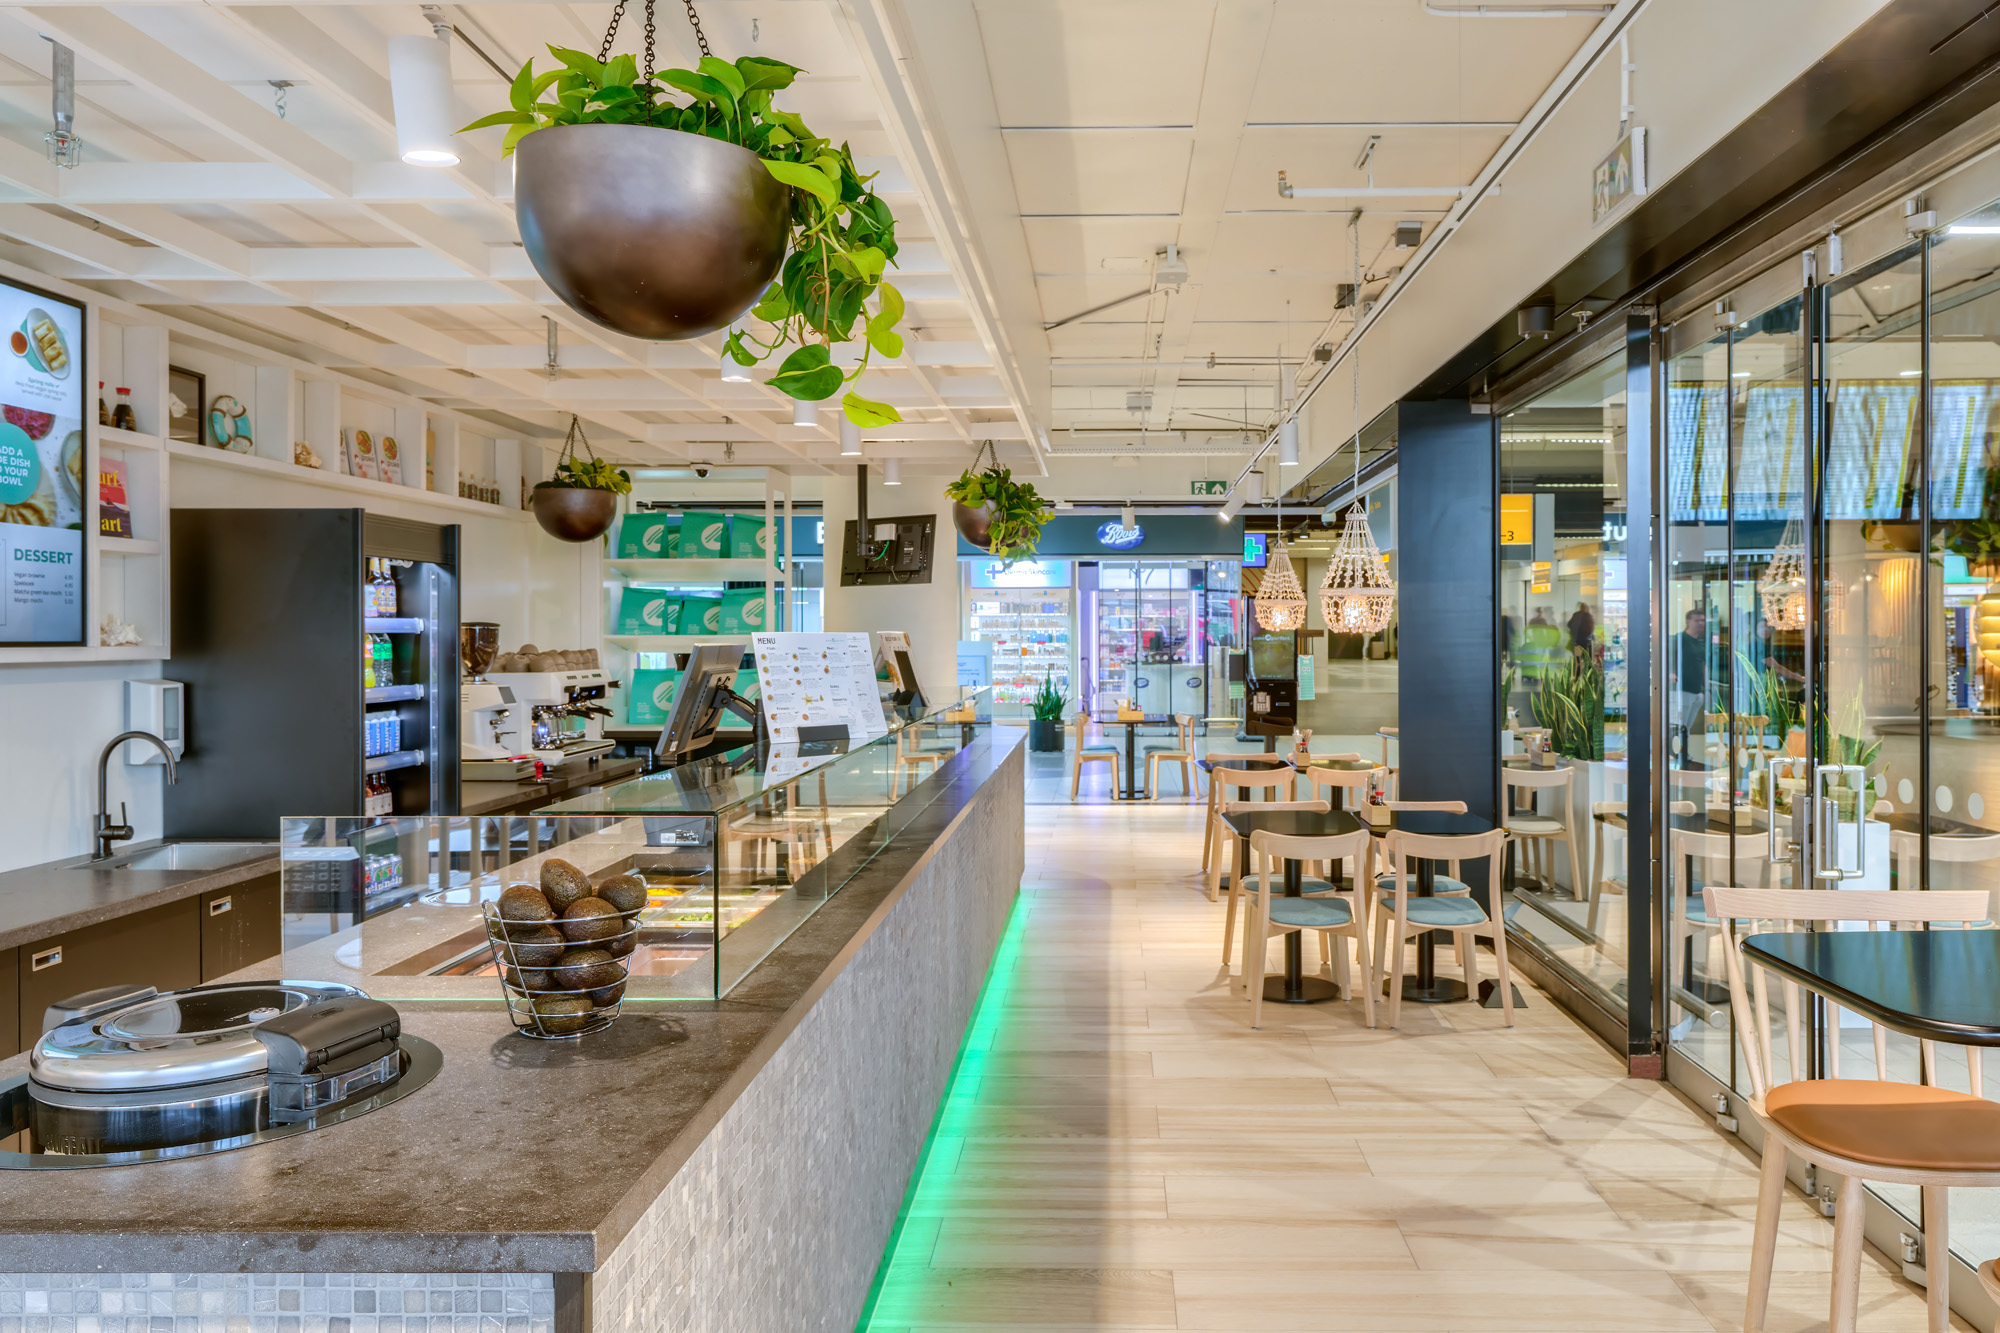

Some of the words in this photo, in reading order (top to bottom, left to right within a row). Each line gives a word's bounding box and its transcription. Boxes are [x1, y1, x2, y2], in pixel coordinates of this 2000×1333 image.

[17, 449, 23, 457] A
[10, 457, 30, 467] DISH
[4, 466, 28, 477] YOUR
[101, 518, 122, 532] art
[14, 548, 73, 564] DESSERT
[1028, 568, 1057, 576] Skincare
[757, 637, 776, 645] MENU
